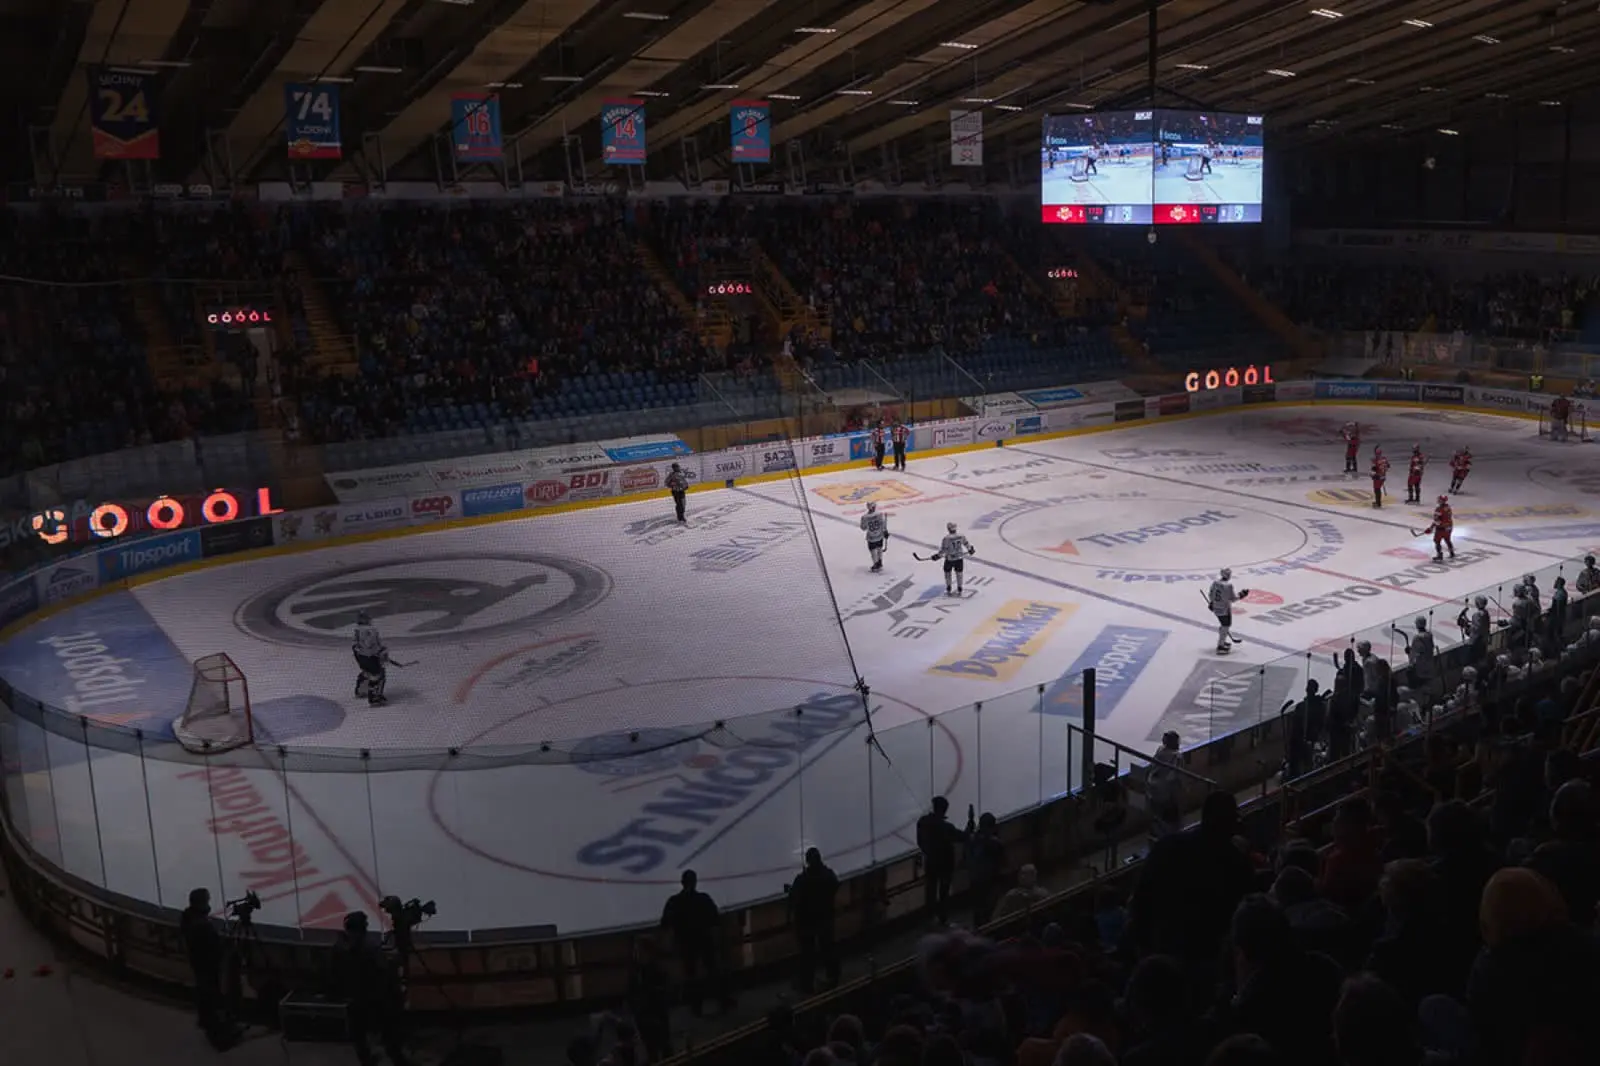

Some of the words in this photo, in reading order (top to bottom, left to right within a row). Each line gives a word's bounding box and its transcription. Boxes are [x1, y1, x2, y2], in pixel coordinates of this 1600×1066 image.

[98, 87, 150, 121] 24
[293, 89, 333, 121] 74
[465, 112, 491, 136] 16
[611, 116, 637, 138] 14
[570, 471, 608, 489] BDI
[715, 461, 742, 473] SWAN
[366, 507, 403, 521] LOKO
[1078, 509, 1238, 549] Tipsport
[120, 537, 191, 570] Tipsport
[1097, 569, 1223, 583] Tipspor
[1250, 584, 1382, 626] MESTO
[1375, 547, 1502, 587] ZVOLEN
[37, 631, 147, 711] Tipsport
[178, 763, 320, 891] Kaufland
